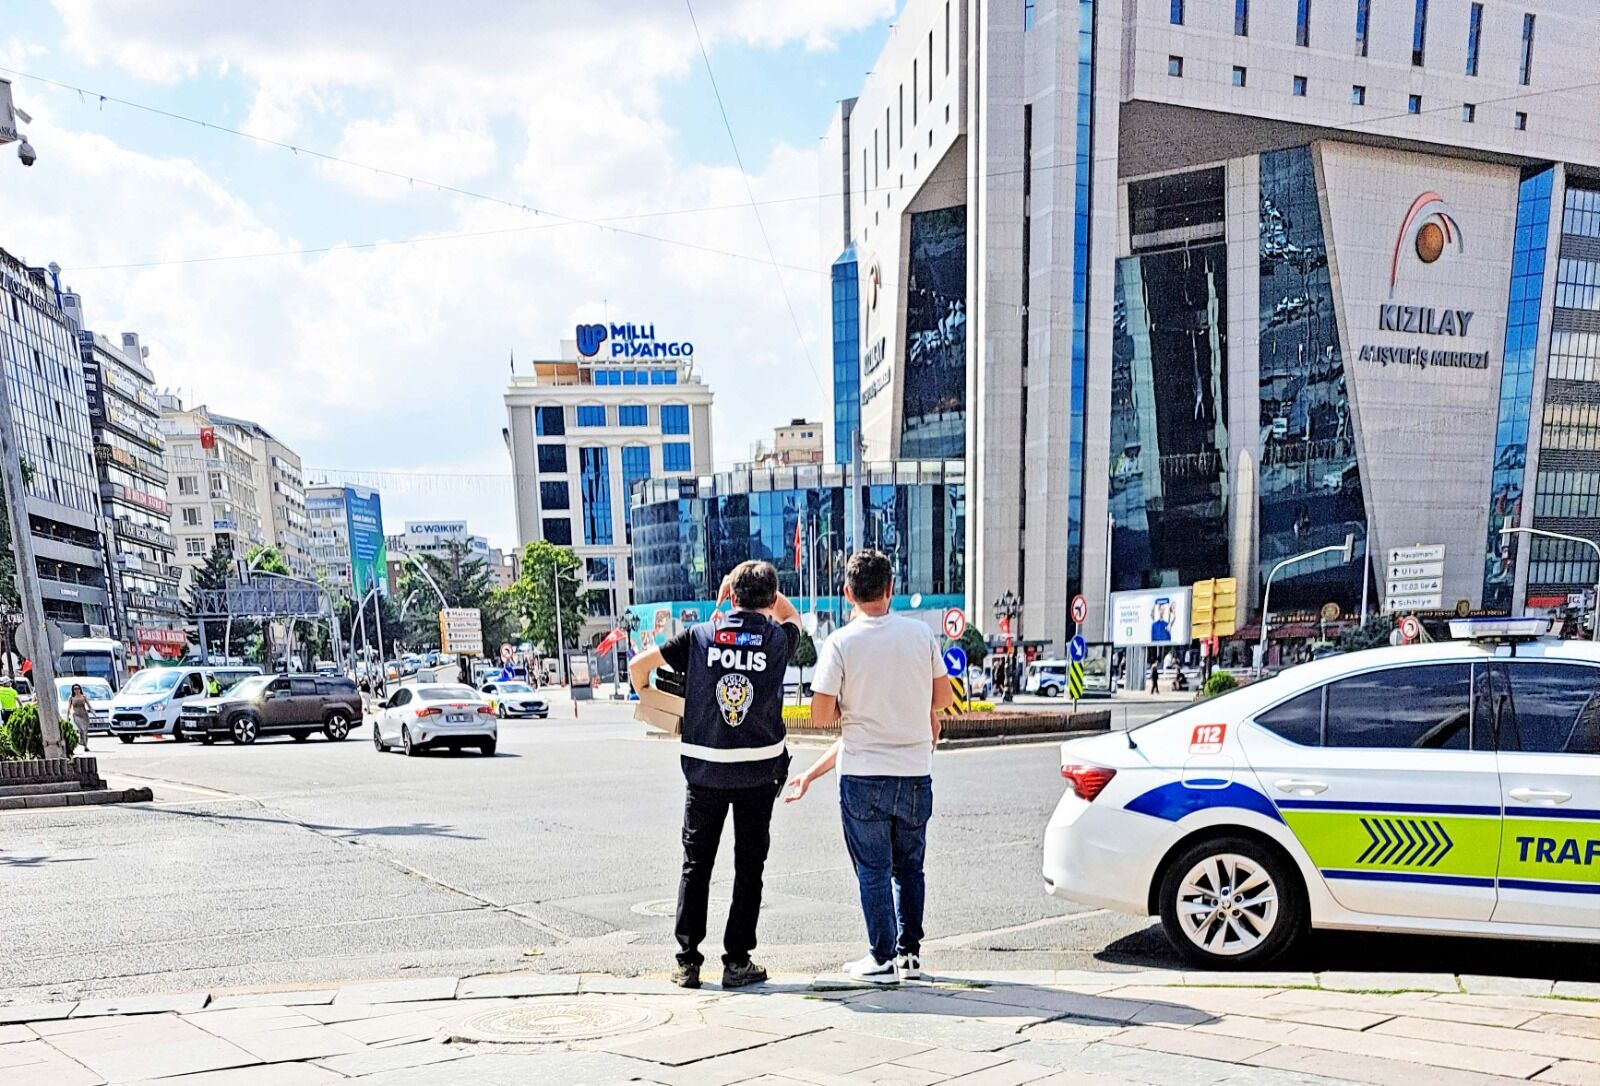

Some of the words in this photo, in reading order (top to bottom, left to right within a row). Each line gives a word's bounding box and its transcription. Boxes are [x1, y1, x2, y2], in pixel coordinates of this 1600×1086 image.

[1378, 303, 1475, 337] KIZILAY
[1196, 726, 1222, 743] 112
[1516, 836, 1600, 866] TRAF
